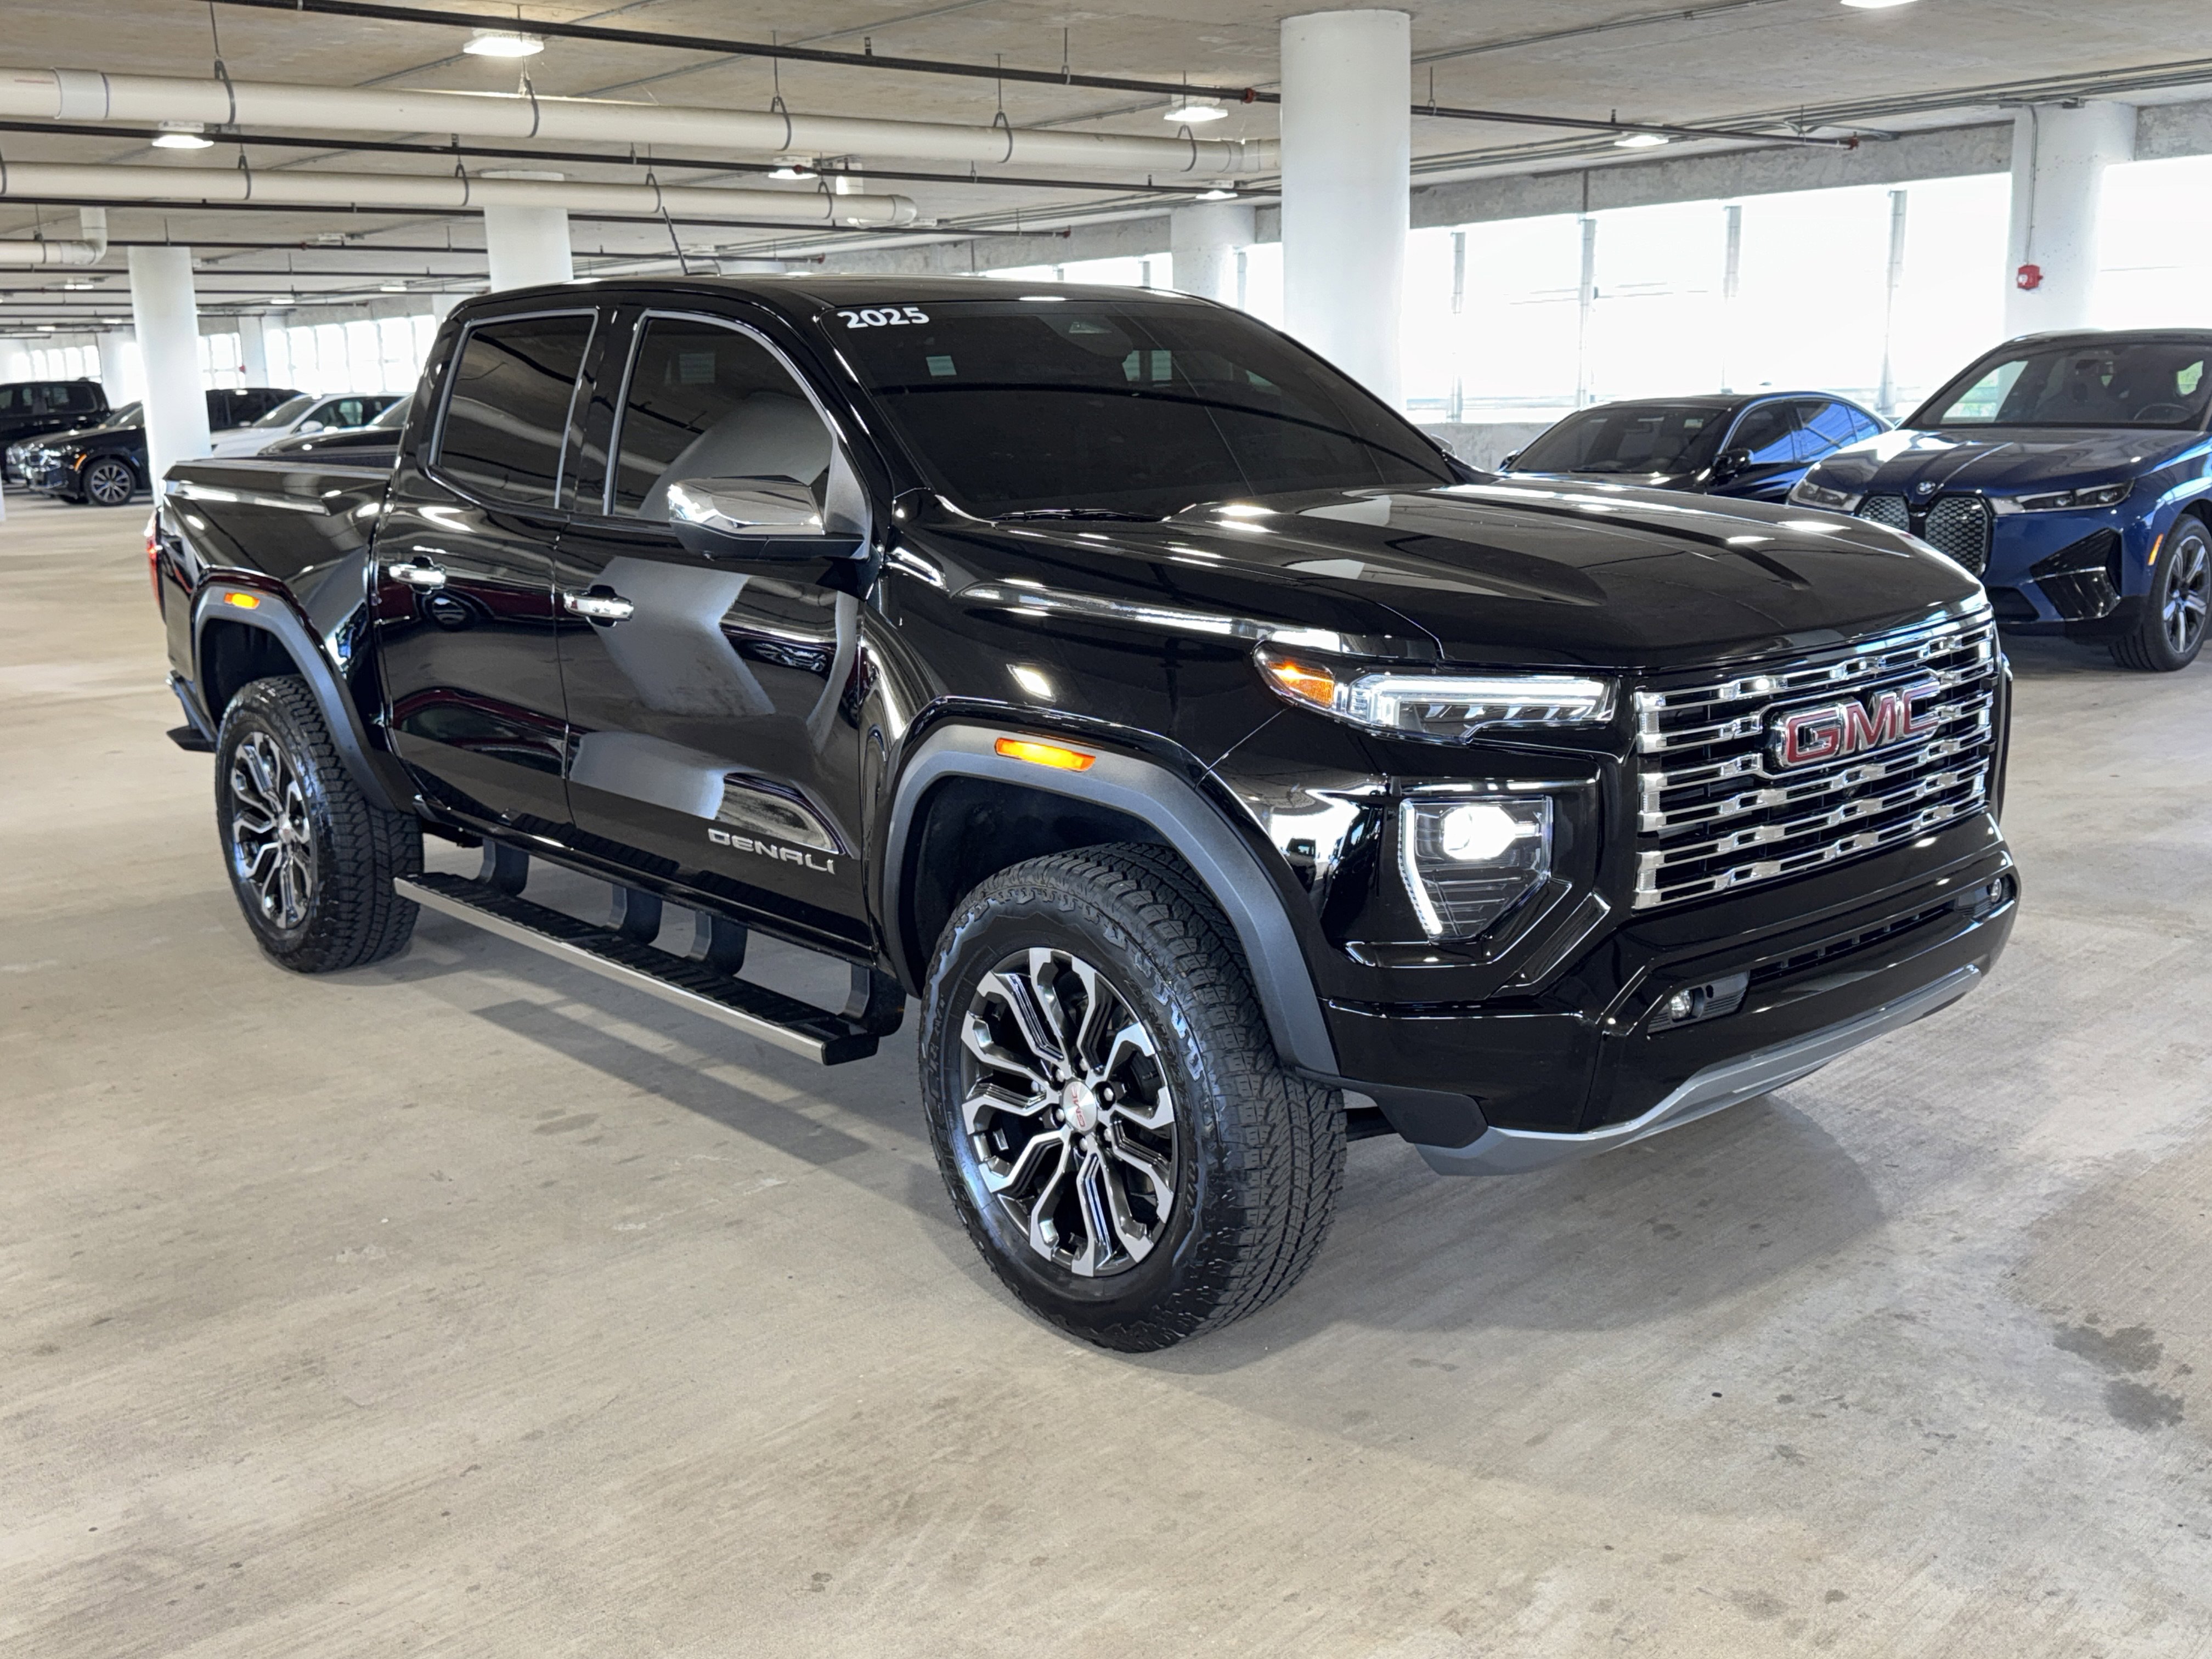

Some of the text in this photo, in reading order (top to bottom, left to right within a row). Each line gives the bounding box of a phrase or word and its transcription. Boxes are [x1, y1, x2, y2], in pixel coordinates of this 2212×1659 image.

[837, 307, 929, 329] 2025
[1776, 676, 1940, 766] GMC
[708, 828, 836, 874] DENALI
[1070, 1086, 1086, 1127] GMC
